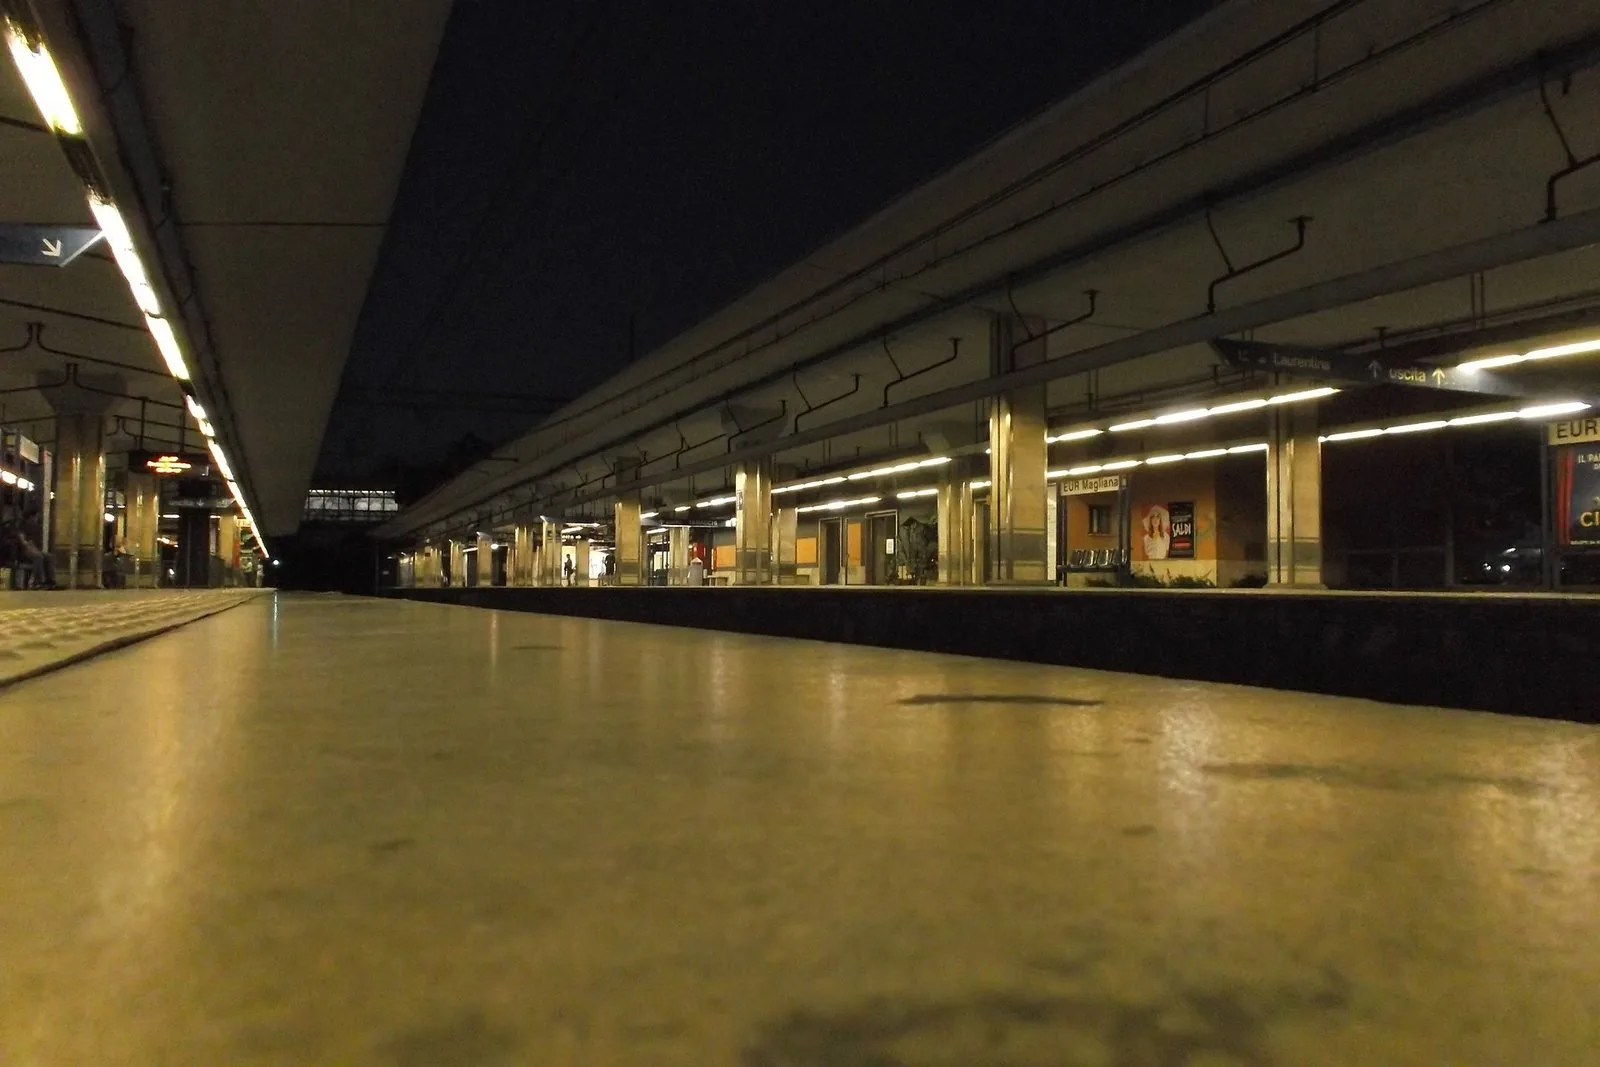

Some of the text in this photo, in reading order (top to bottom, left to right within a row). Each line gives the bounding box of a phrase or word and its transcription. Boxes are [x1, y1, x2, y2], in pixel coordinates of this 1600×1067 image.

[1389, 366, 1426, 382] uscita
[1557, 420, 1598, 438] EUR
[1063, 478, 1119, 492] EUR Magliana
[1172, 522, 1192, 538] SALDI
